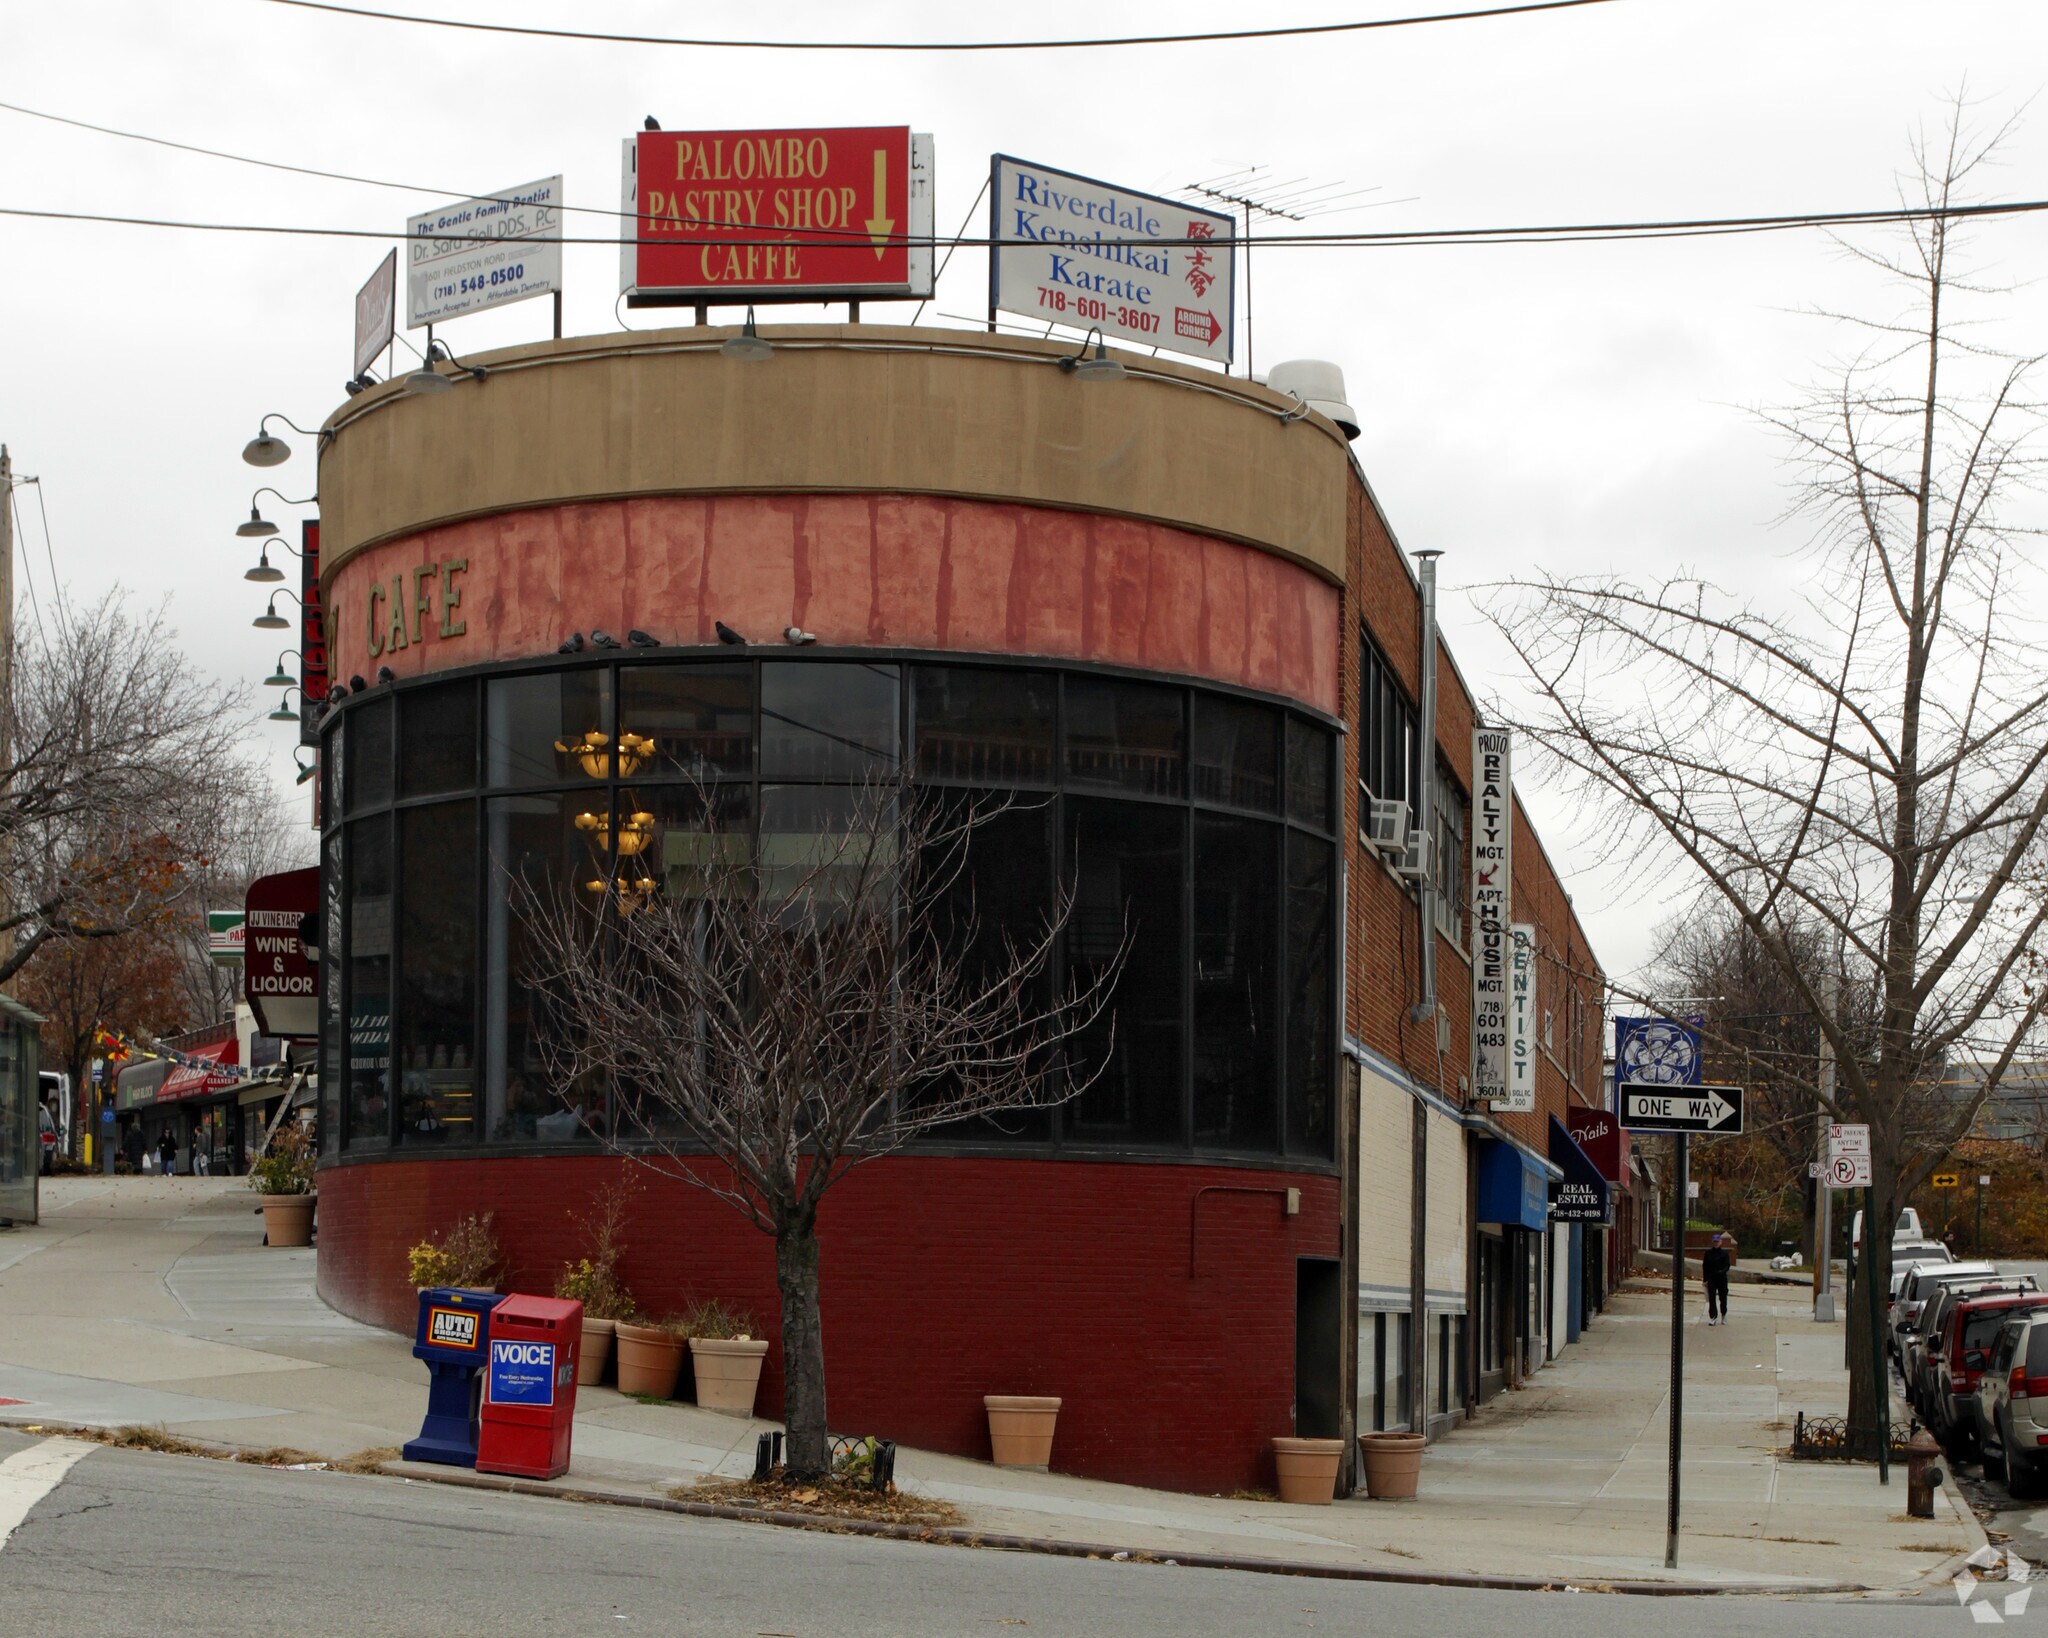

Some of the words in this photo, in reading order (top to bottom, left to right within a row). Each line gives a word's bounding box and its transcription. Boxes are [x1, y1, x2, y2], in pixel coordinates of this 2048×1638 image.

[675, 137, 829, 181] PALOMBO
[418, 223, 434, 236] The
[438, 212, 471, 229] Gentle
[475, 201, 509, 219] Family
[513, 188, 551, 208] Dentist
[647, 189, 768, 232] PASTRY
[774, 186, 857, 230] SHOP
[1015, 172, 1161, 238] Riverdale
[1013, 208, 1171, 277] Kenshikai
[414, 244, 429, 262] Dr.
[701, 233, 802, 282] CAFFÉ
[434, 283, 457, 300] (718)
[461, 263, 524, 294] 548-0500
[1049, 253, 1152, 305] Karate
[414, 308, 441, 320] Insurance
[443, 300, 470, 313] Accepted
[1037, 286, 1161, 334] 718-601-3607
[1177, 310, 1212, 328] AROUND
[1177, 322, 1211, 341] CORNER
[367, 558, 468, 658] CAFE
[1478, 734, 1508, 755] PROTO
[1482, 754, 1501, 843] REALTY
[1476, 846, 1504, 860] MGT.
[1477, 890, 1504, 903] APT.
[255, 936, 298, 954] WINE
[1480, 905, 1501, 977] HOUSE
[273, 956, 284, 973] &
[251, 976, 313, 994] LIQUOR
[1478, 980, 1505, 993] MGT.
[1480, 1002, 1504, 1013] (718)
[1513, 931, 1527, 1079] DENTIST
[1478, 1014, 1506, 1028] 601
[1476, 1034, 1506, 1047] 1483
[1476, 1085, 1497, 1097] 3601
[1499, 1086, 1506, 1096] A
[1638, 1098, 1672, 1116] ONE
[1688, 1101, 1724, 1118] WAY
[1570, 1121, 1609, 1145] Nails
[1830, 1126, 1841, 1138] NO
[1557, 1194, 1598, 1204] ESTATE
[1562, 1184, 1593, 1194] REAL
[1553, 1209, 1601, 1218] 718-432-0198
[434, 1313, 474, 1334] AUTO
[497, 1344, 552, 1366] VOICE
